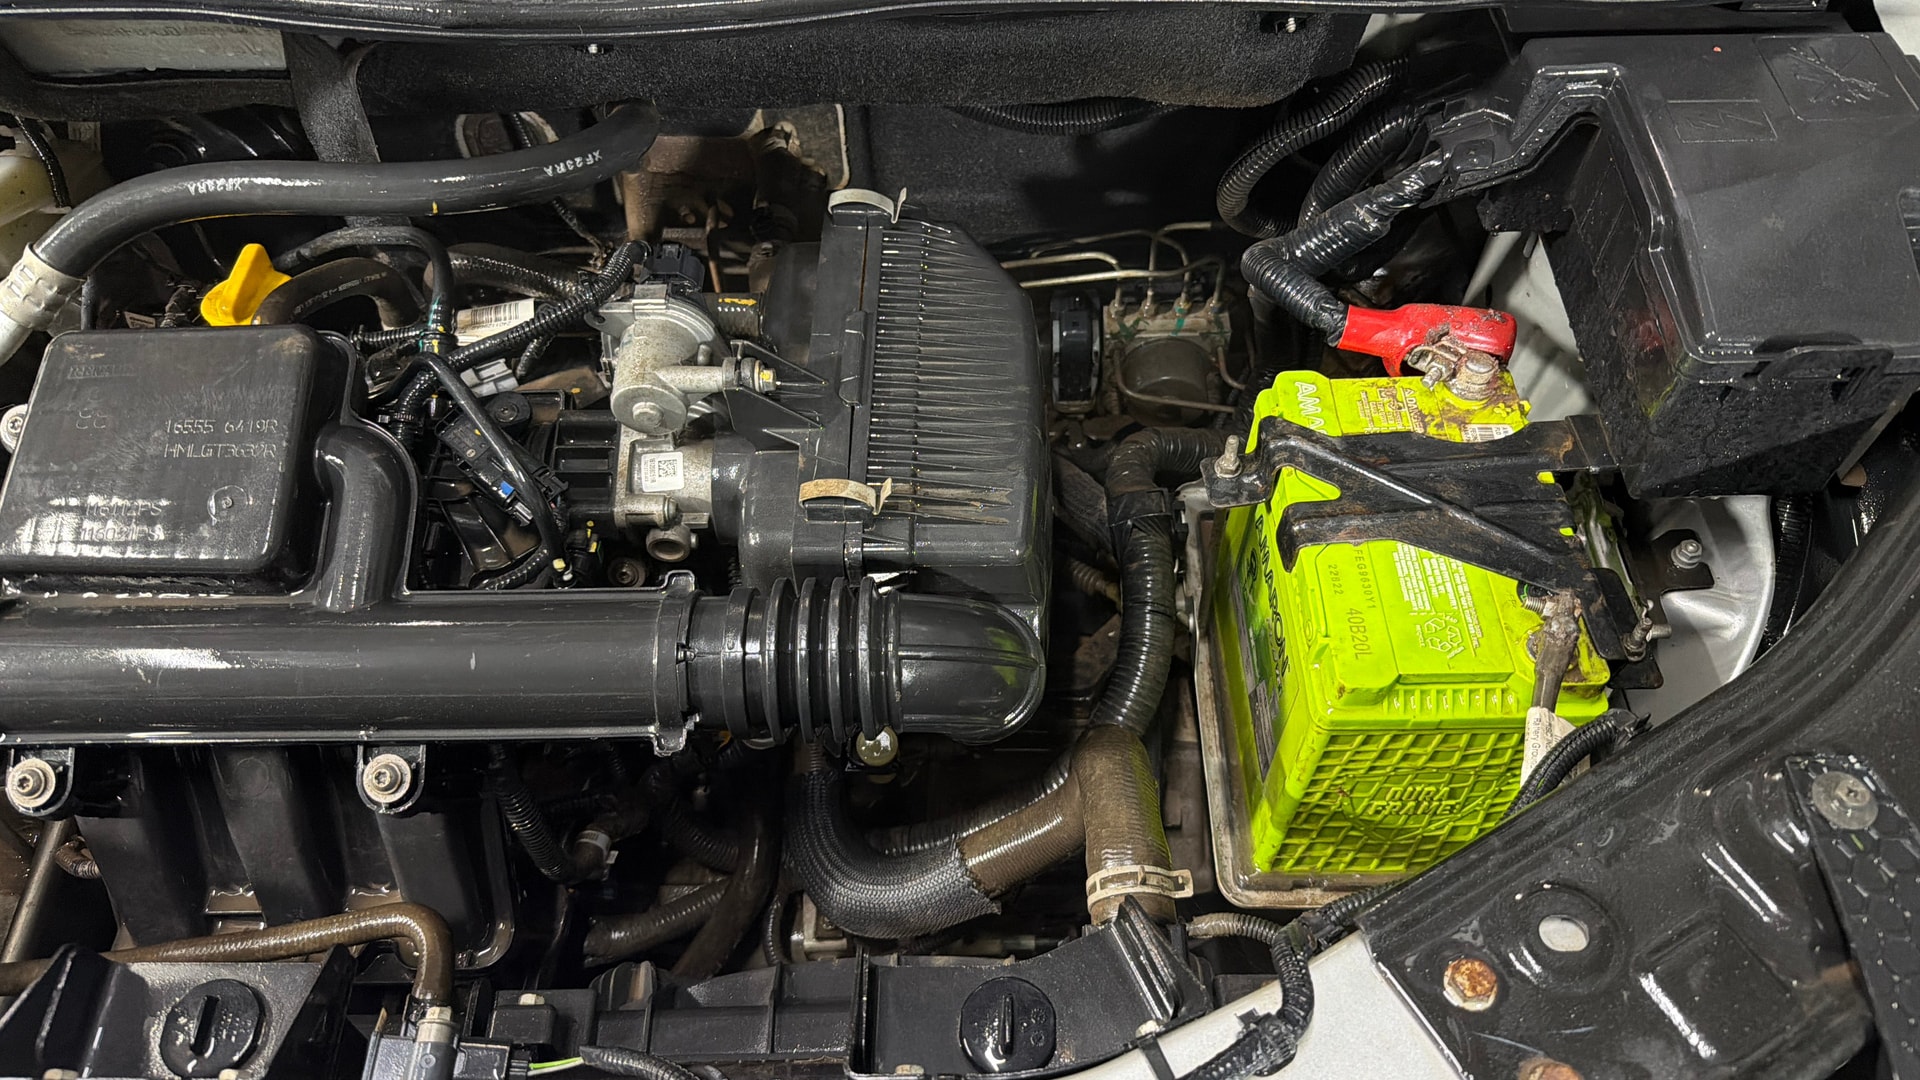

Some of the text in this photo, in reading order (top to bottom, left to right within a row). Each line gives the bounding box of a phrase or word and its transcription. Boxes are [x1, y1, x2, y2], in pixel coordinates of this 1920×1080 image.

[543, 149, 603, 177] XF23RA
[164, 419, 217, 434] 16555
[1294, 381, 1329, 435] AMA
[1255, 514, 1289, 677] AMARON
[1346, 607, 1374, 660] 40B20L
